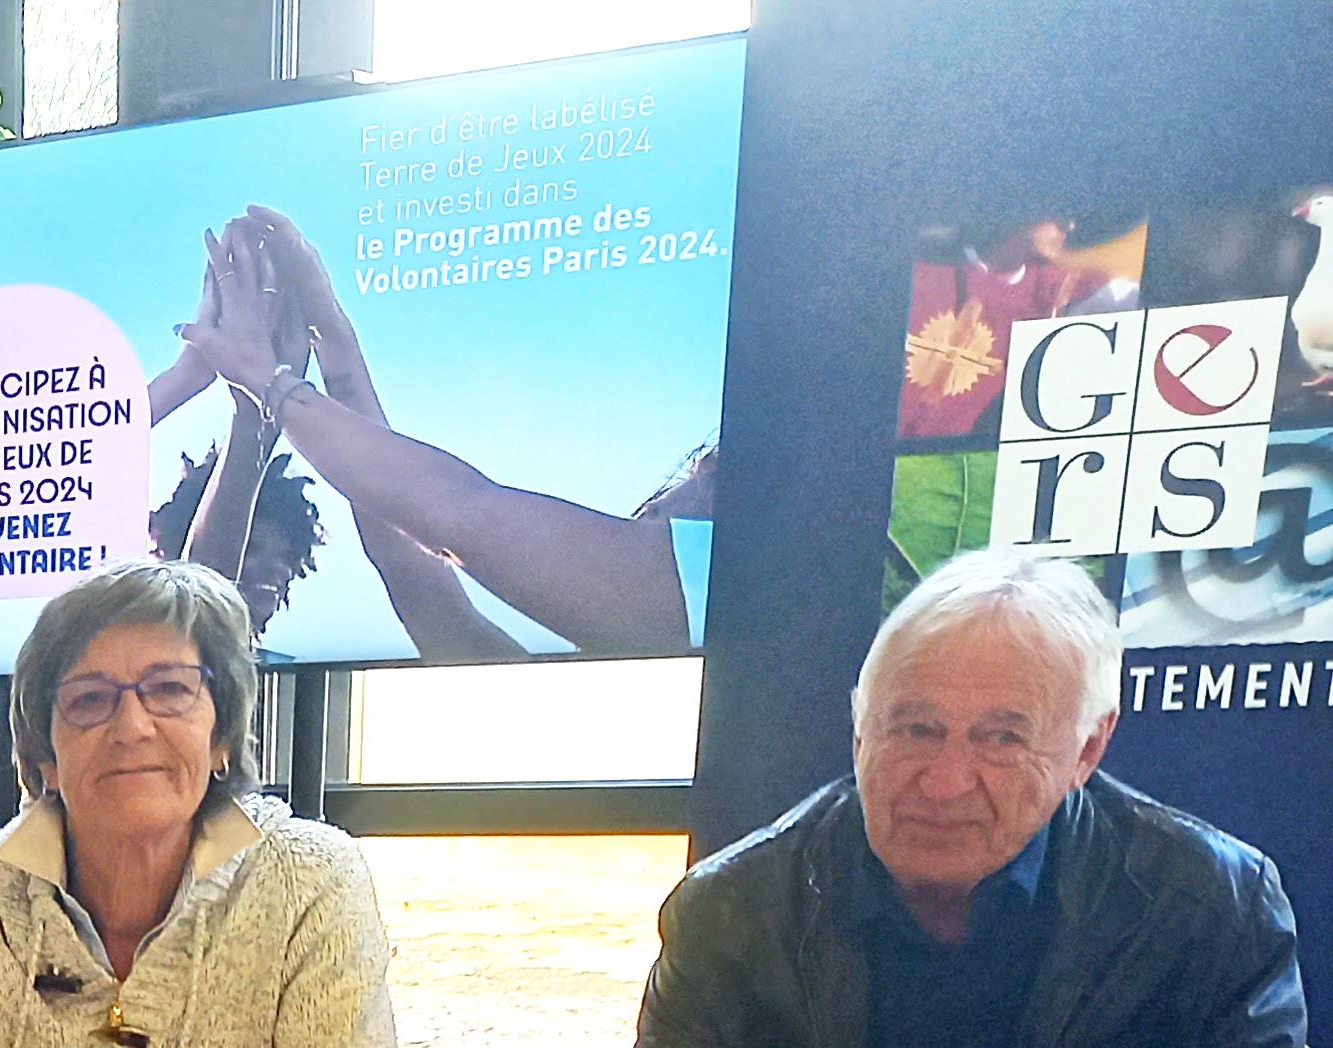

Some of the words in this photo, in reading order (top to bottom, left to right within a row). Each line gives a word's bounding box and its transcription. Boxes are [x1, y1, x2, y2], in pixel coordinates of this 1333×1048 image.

[361, 123, 420, 154] Fier
[430, 109, 518, 145] d'être
[532, 86, 656, 131] labélisé
[360, 160, 436, 190] Terre
[448, 150, 484, 178] de
[494, 142, 566, 174] Jeux
[578, 125, 653, 162] 2024
[358, 200, 385, 226] et
[396, 181, 492, 221] investi
[504, 179, 579, 208] dans
[356, 233, 384, 261] le
[394, 212, 583, 257] Programme
[593, 205, 651, 233] des
[355, 252, 532, 295] Volontaires
[542, 241, 628, 275] Paris
[637, 228, 728, 265] 2024.
[89, 355, 106, 390] À
[61, 439, 93, 466] DE
[20, 476, 93, 506] 2024
